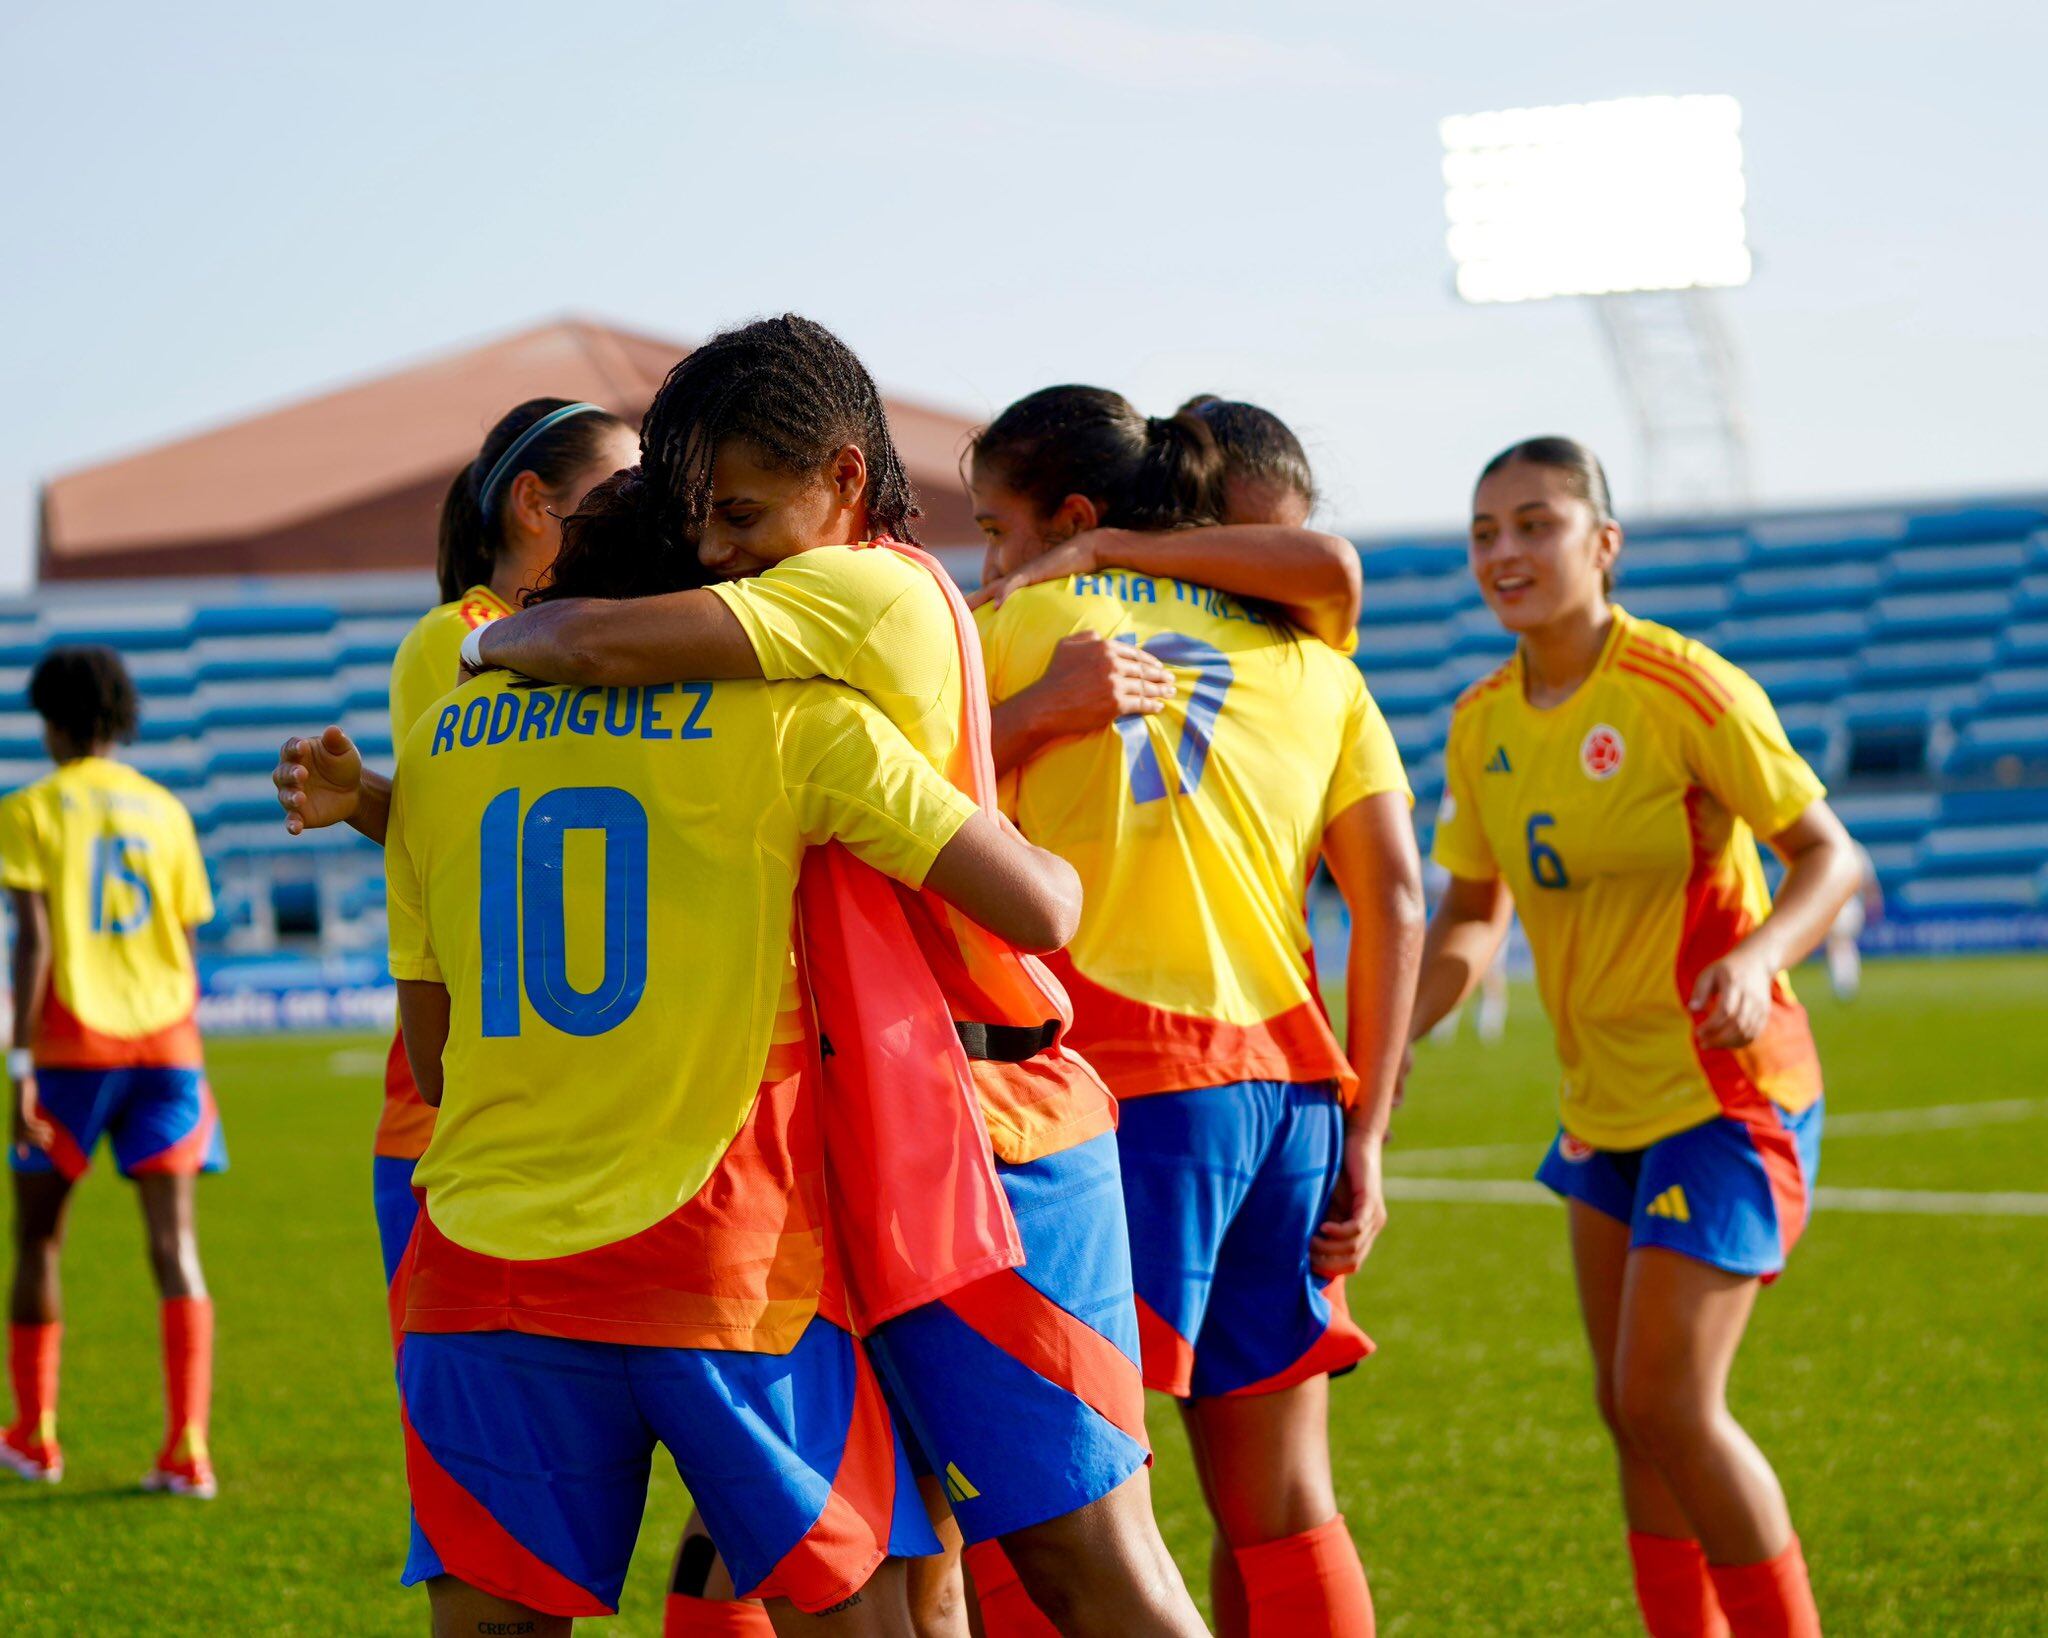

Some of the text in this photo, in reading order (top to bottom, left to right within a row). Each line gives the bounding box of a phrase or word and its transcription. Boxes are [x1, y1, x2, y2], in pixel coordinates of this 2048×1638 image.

[431, 682, 713, 757] RODRIGUEZ
[1113, 631, 1235, 805] 17
[89, 836, 153, 934] 15
[1526, 813, 1568, 889] 6
[480, 786, 648, 1038] 10
[478, 1621, 535, 1635] CRECER
